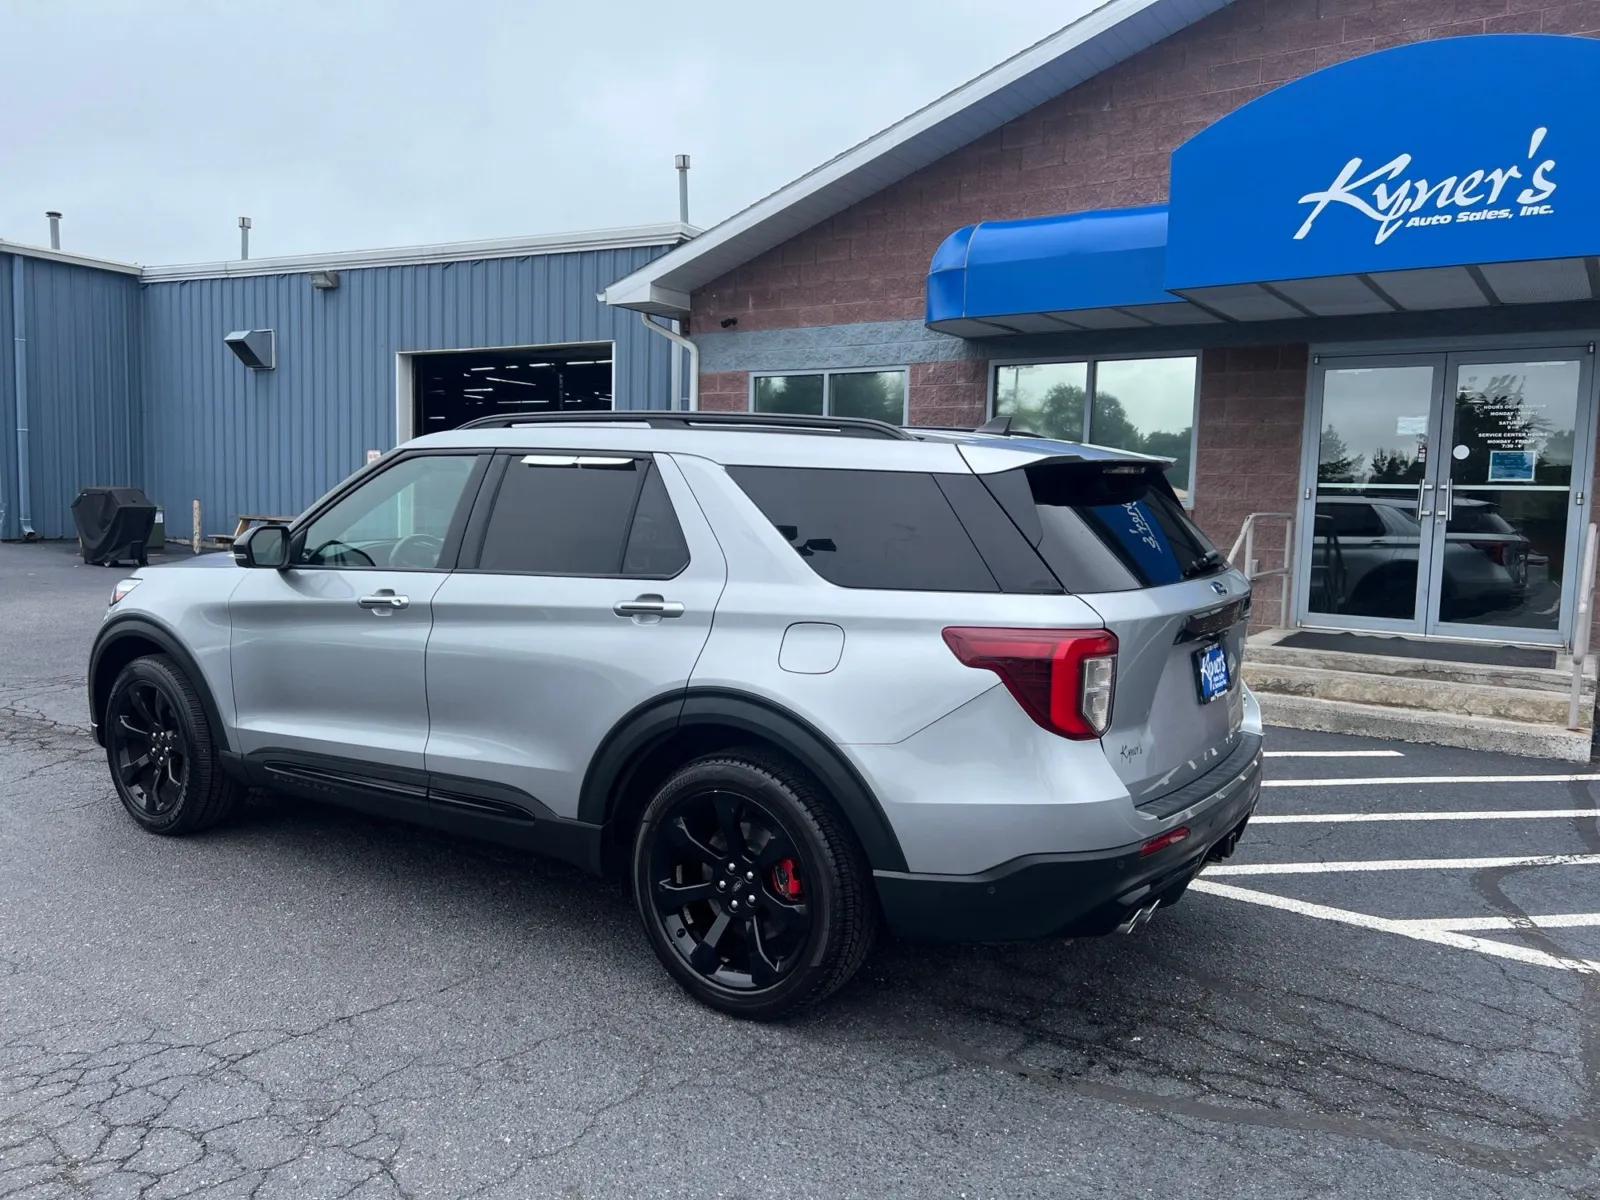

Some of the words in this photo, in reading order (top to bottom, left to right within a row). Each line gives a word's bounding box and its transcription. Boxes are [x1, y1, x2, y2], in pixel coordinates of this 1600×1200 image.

[1293, 127, 1557, 245] Kyner's
[1405, 214, 1452, 228] Auto
[1456, 208, 1514, 223] Sales,
[1519, 204, 1554, 217] Inc.
